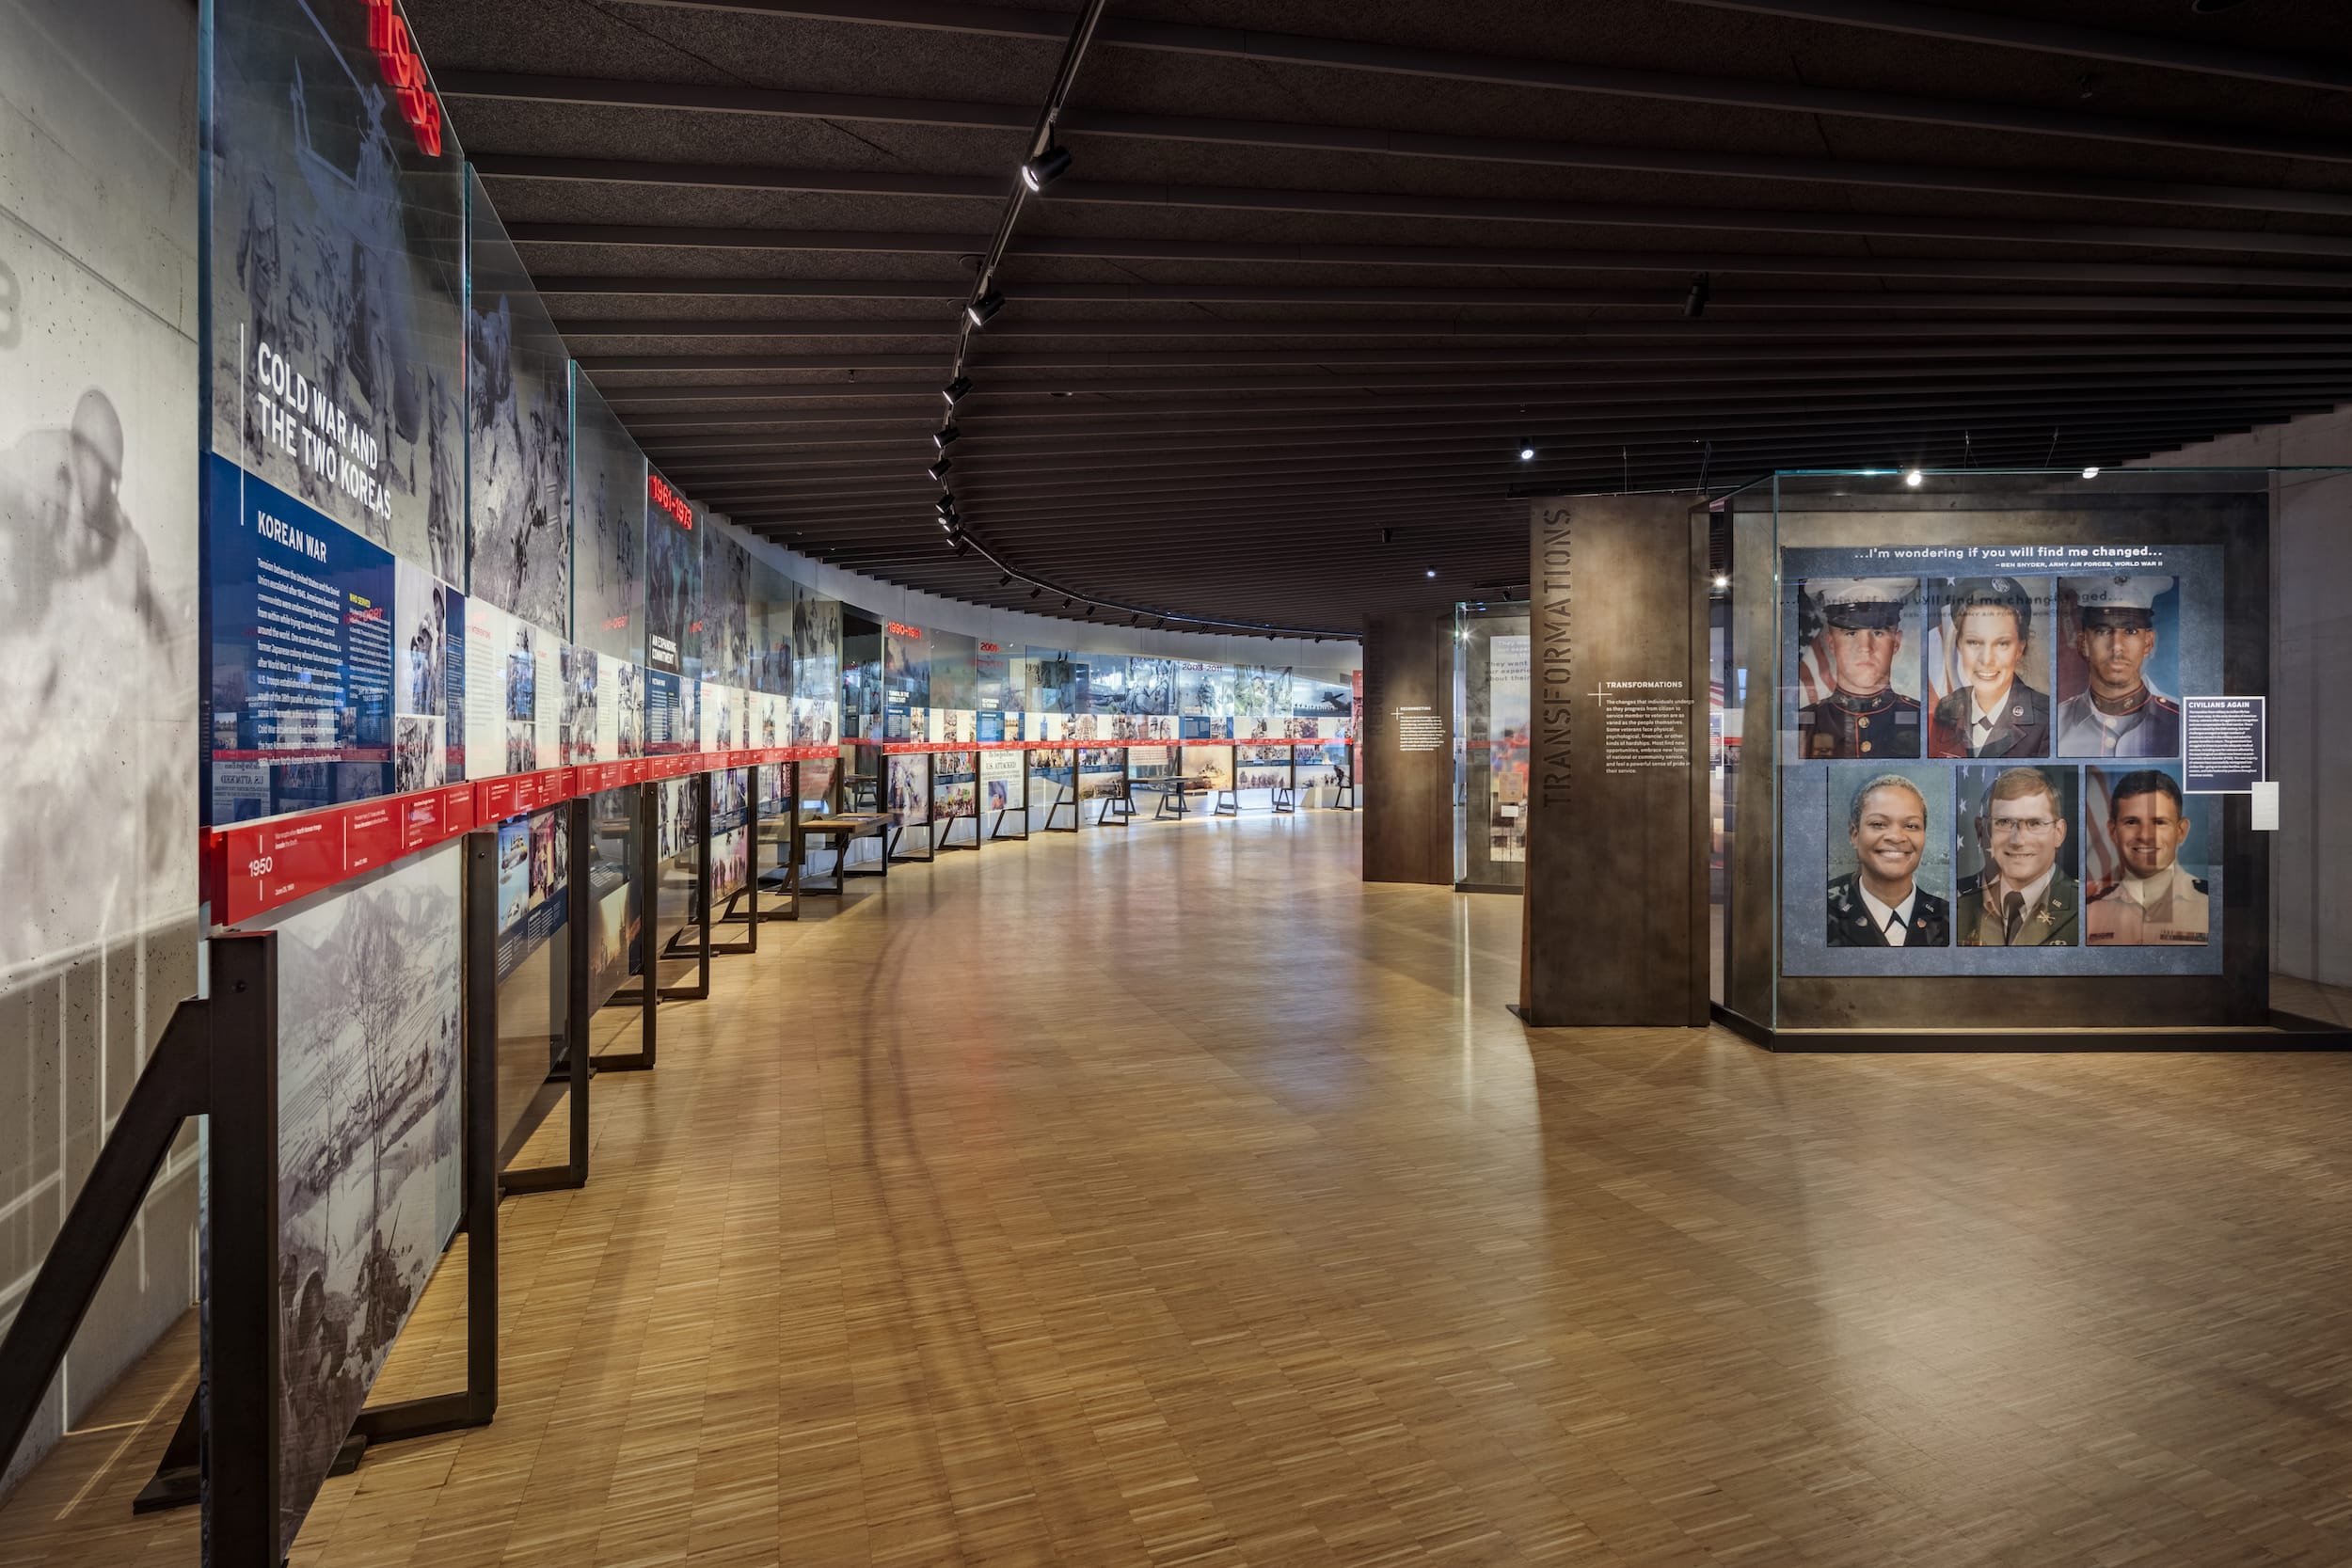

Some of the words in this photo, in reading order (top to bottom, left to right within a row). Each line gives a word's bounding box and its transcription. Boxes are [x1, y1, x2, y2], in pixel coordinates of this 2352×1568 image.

[258, 342, 309, 414] COLD
[313, 388, 347, 448] WAR
[351, 423, 377, 470] AND
[258, 392, 296, 457] THE
[302, 426, 337, 483] TWO
[341, 455, 390, 520] KOREAS
[258, 511, 303, 553] KOREAN
[306, 534, 326, 563] WAR
[1895, 547, 1963, 559] wondering
[1968, 547, 1979, 557] if
[1982, 549, 2006, 559] you
[2010, 547, 2033, 557] will
[2038, 546, 2064, 557] find
[1543, 509, 1571, 808] TRANSFORMATIONS
[248, 856, 273, 878] 1950
